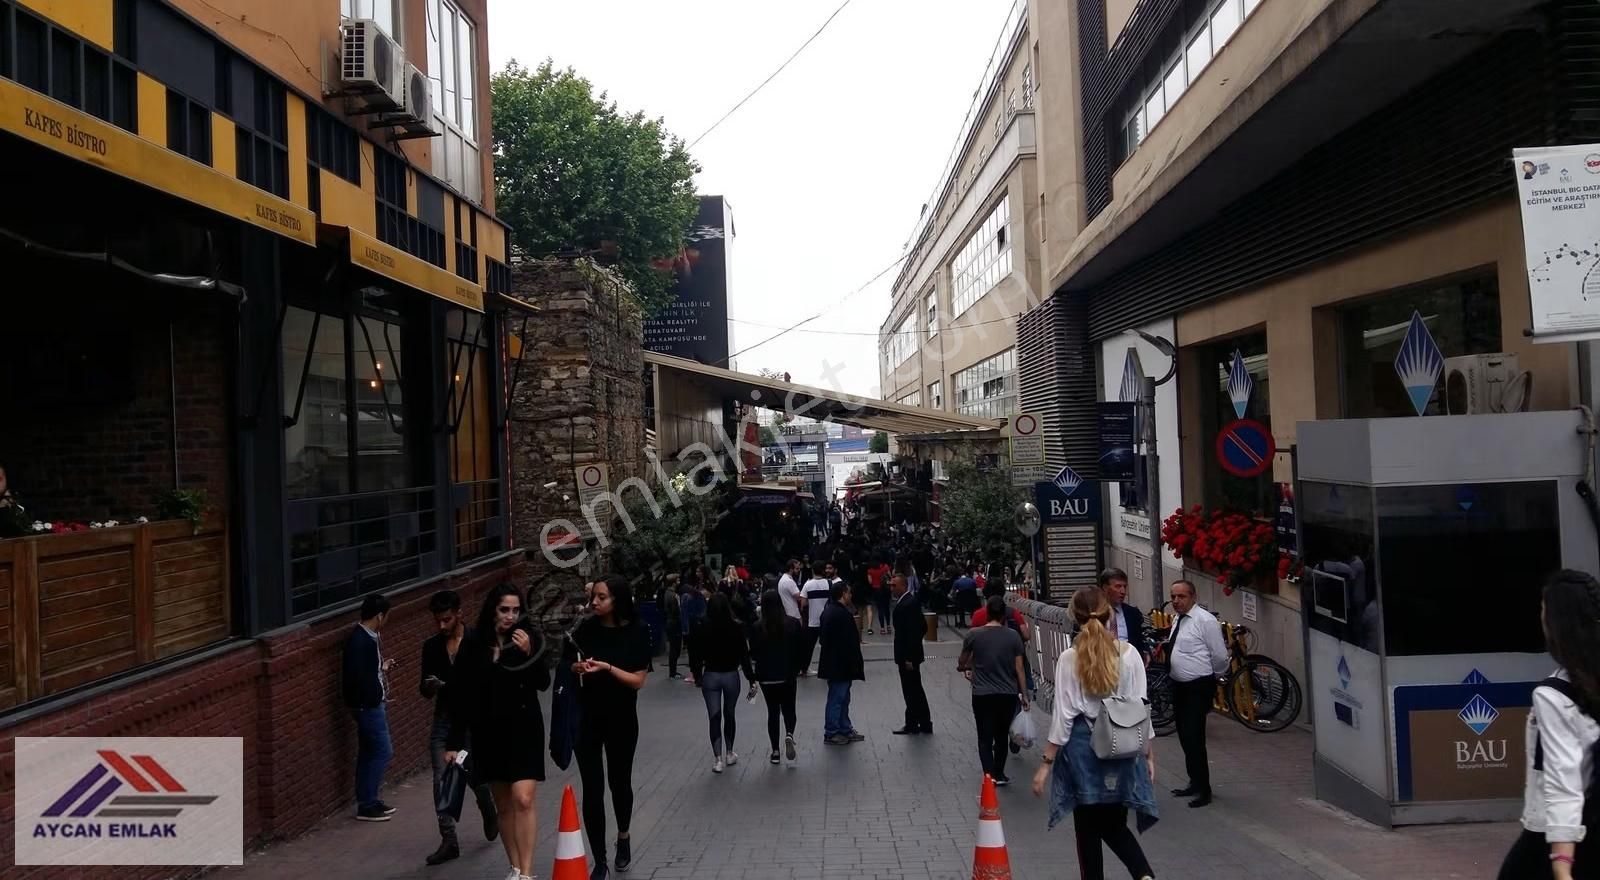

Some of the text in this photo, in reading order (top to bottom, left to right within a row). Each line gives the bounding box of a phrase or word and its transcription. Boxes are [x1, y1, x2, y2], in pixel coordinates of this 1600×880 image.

[24, 107, 106, 156] KAFES BİSTRO
[1532, 188, 1567, 196] İSTANBUL
[256, 204, 278, 222] KAFES
[1552, 202, 1586, 211] MERKEZİ
[1050, 498, 1088, 516] BAU
[1454, 740, 1507, 762] BAU
